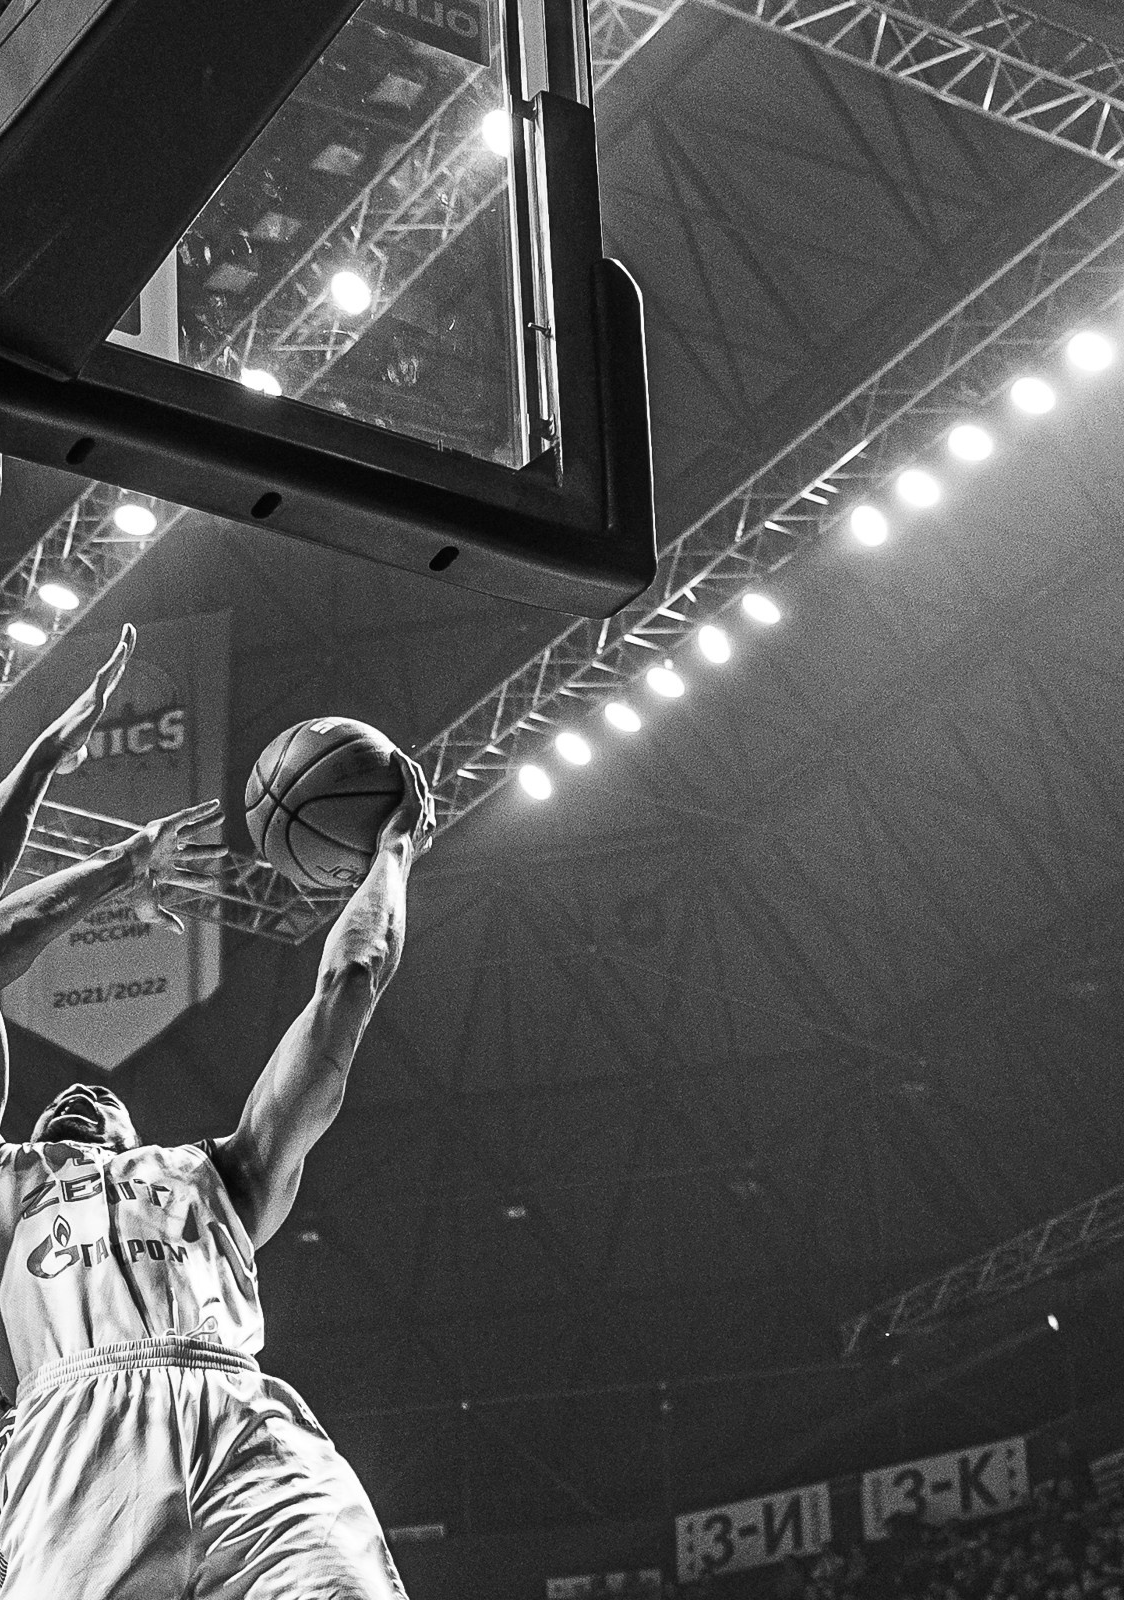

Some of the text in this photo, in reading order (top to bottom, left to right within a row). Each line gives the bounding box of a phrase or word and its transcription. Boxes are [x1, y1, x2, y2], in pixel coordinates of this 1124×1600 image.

[85, 710, 184, 759] NICS
[69, 923, 151, 946] РОССИИ
[53, 976, 167, 1008] 2021/2022
